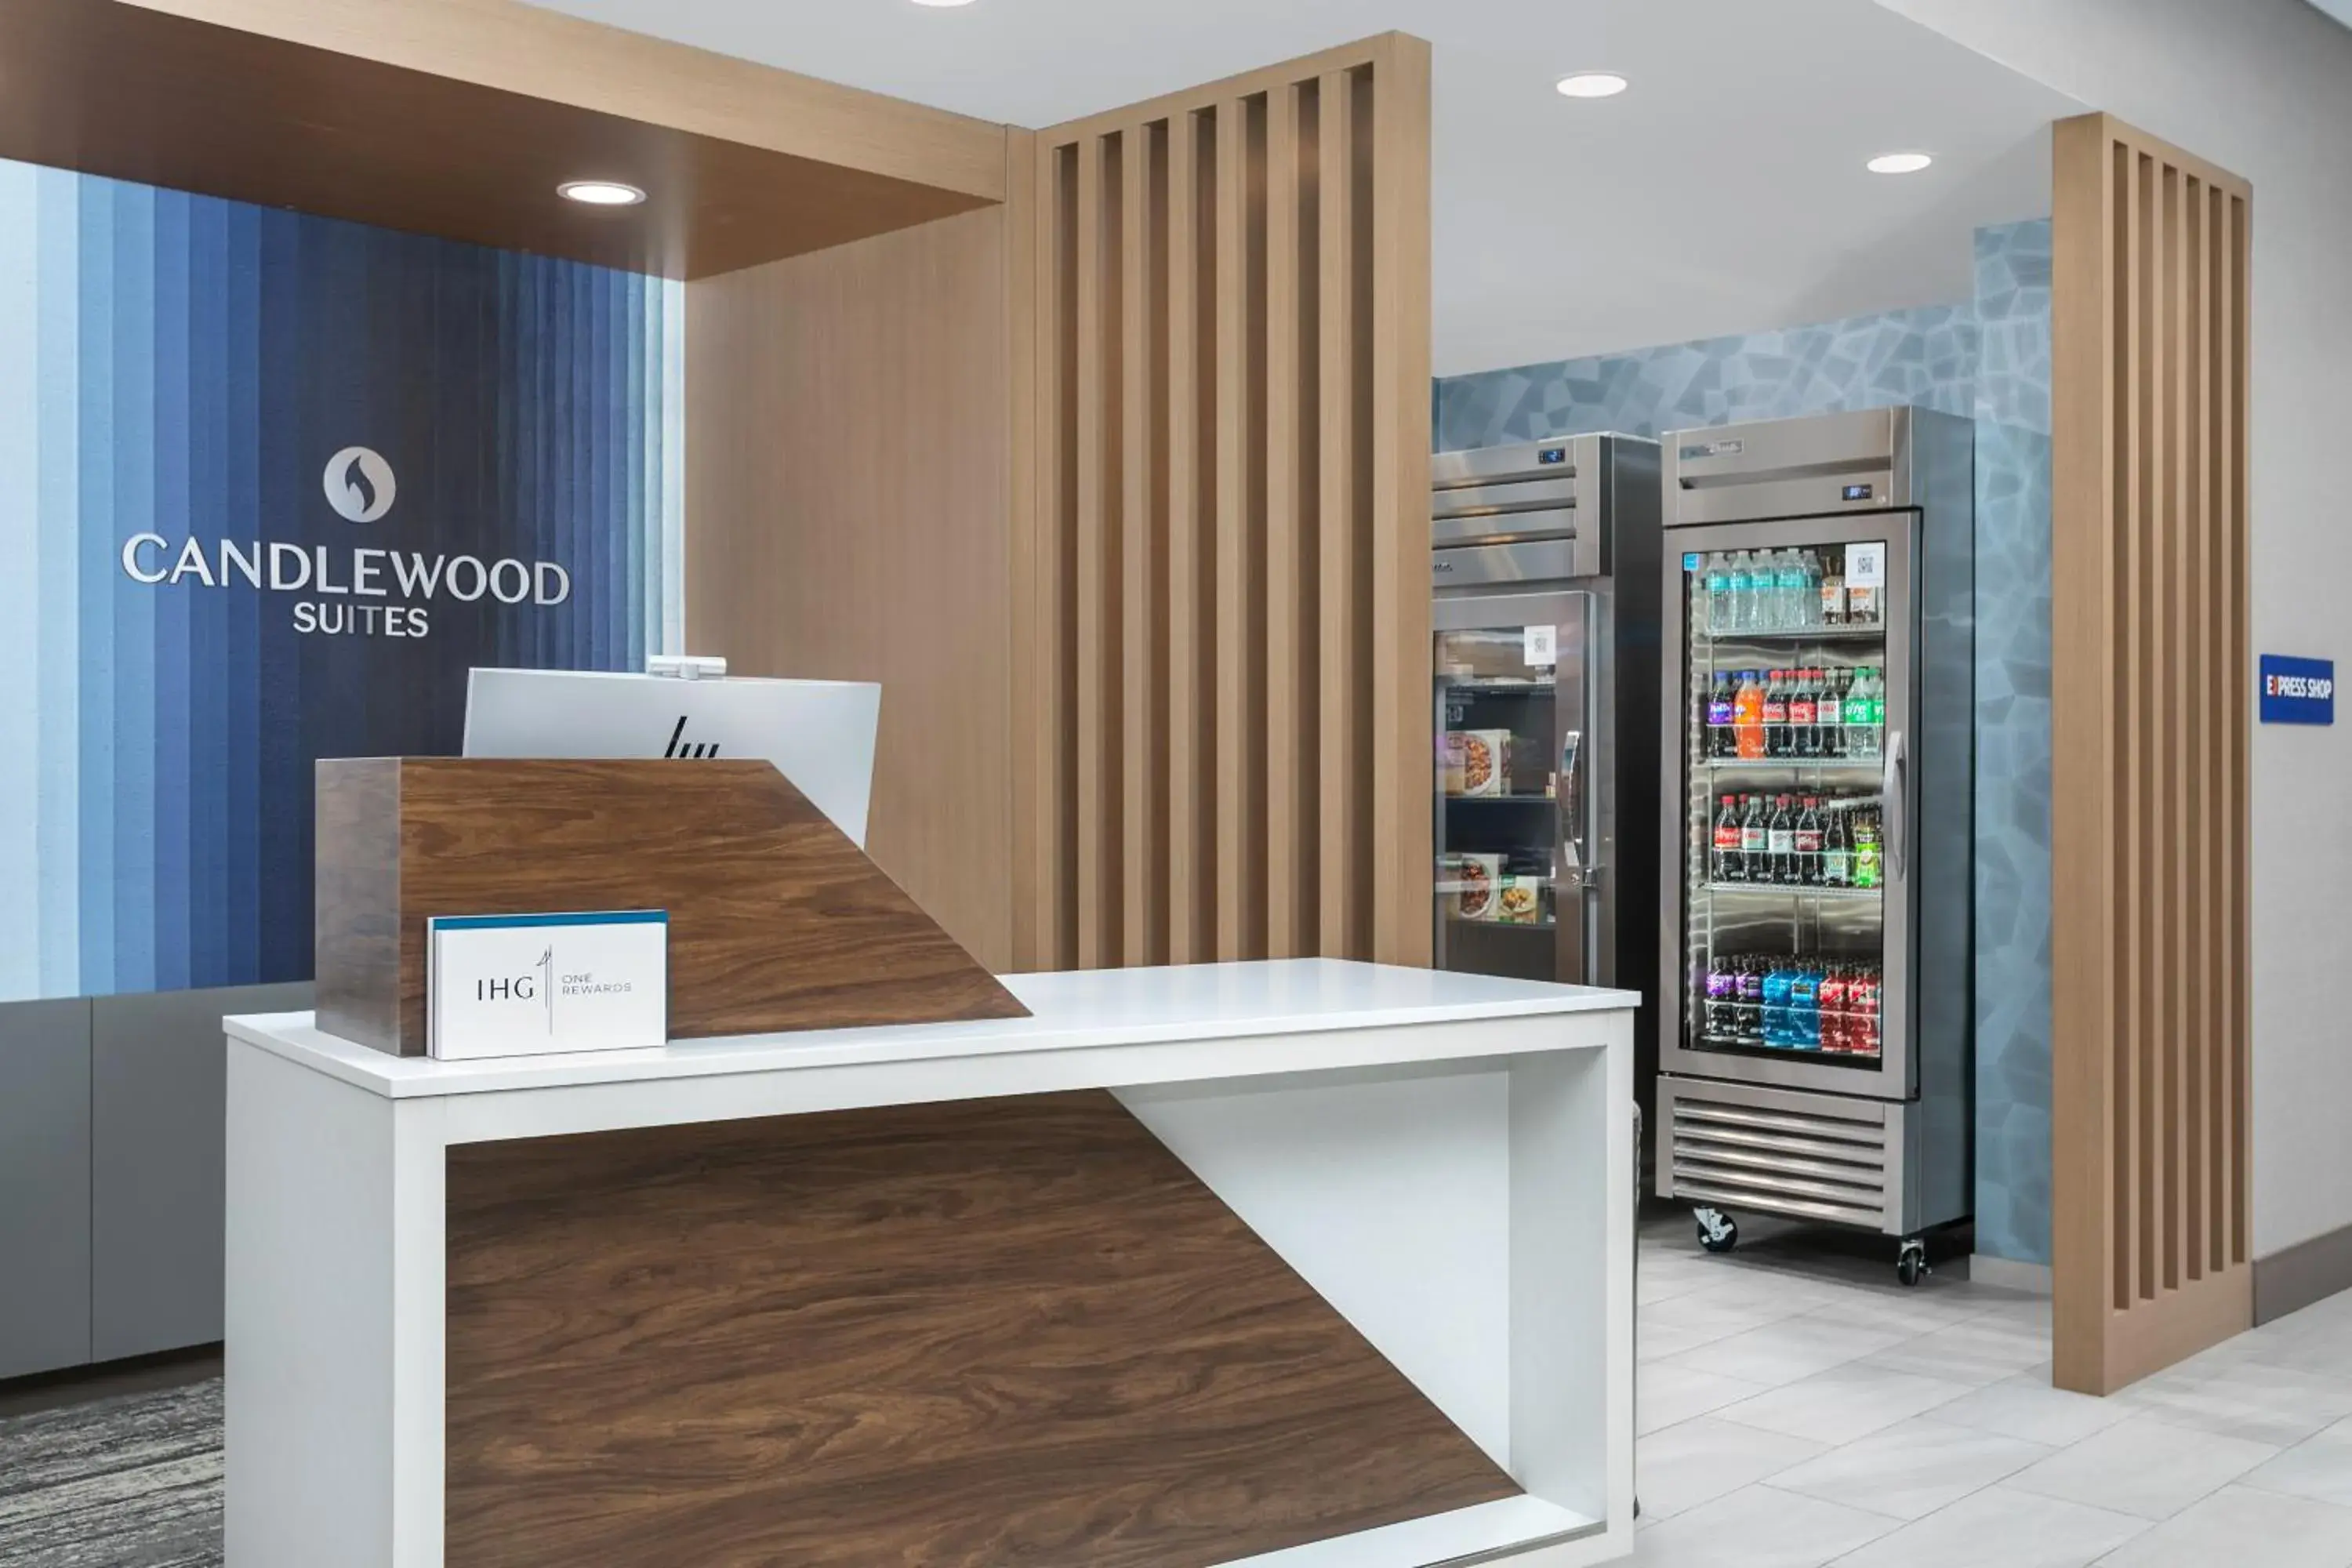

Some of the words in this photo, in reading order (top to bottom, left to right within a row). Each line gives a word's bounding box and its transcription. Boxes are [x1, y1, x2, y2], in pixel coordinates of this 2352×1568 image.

[122, 532, 570, 605] CANDLEWOOD
[292, 601, 430, 637] SUITES
[2307, 677, 2332, 699] SHOP
[477, 976, 534, 1000] IHG
[561, 973, 592, 984] ONE
[561, 982, 632, 995] REWARDS
